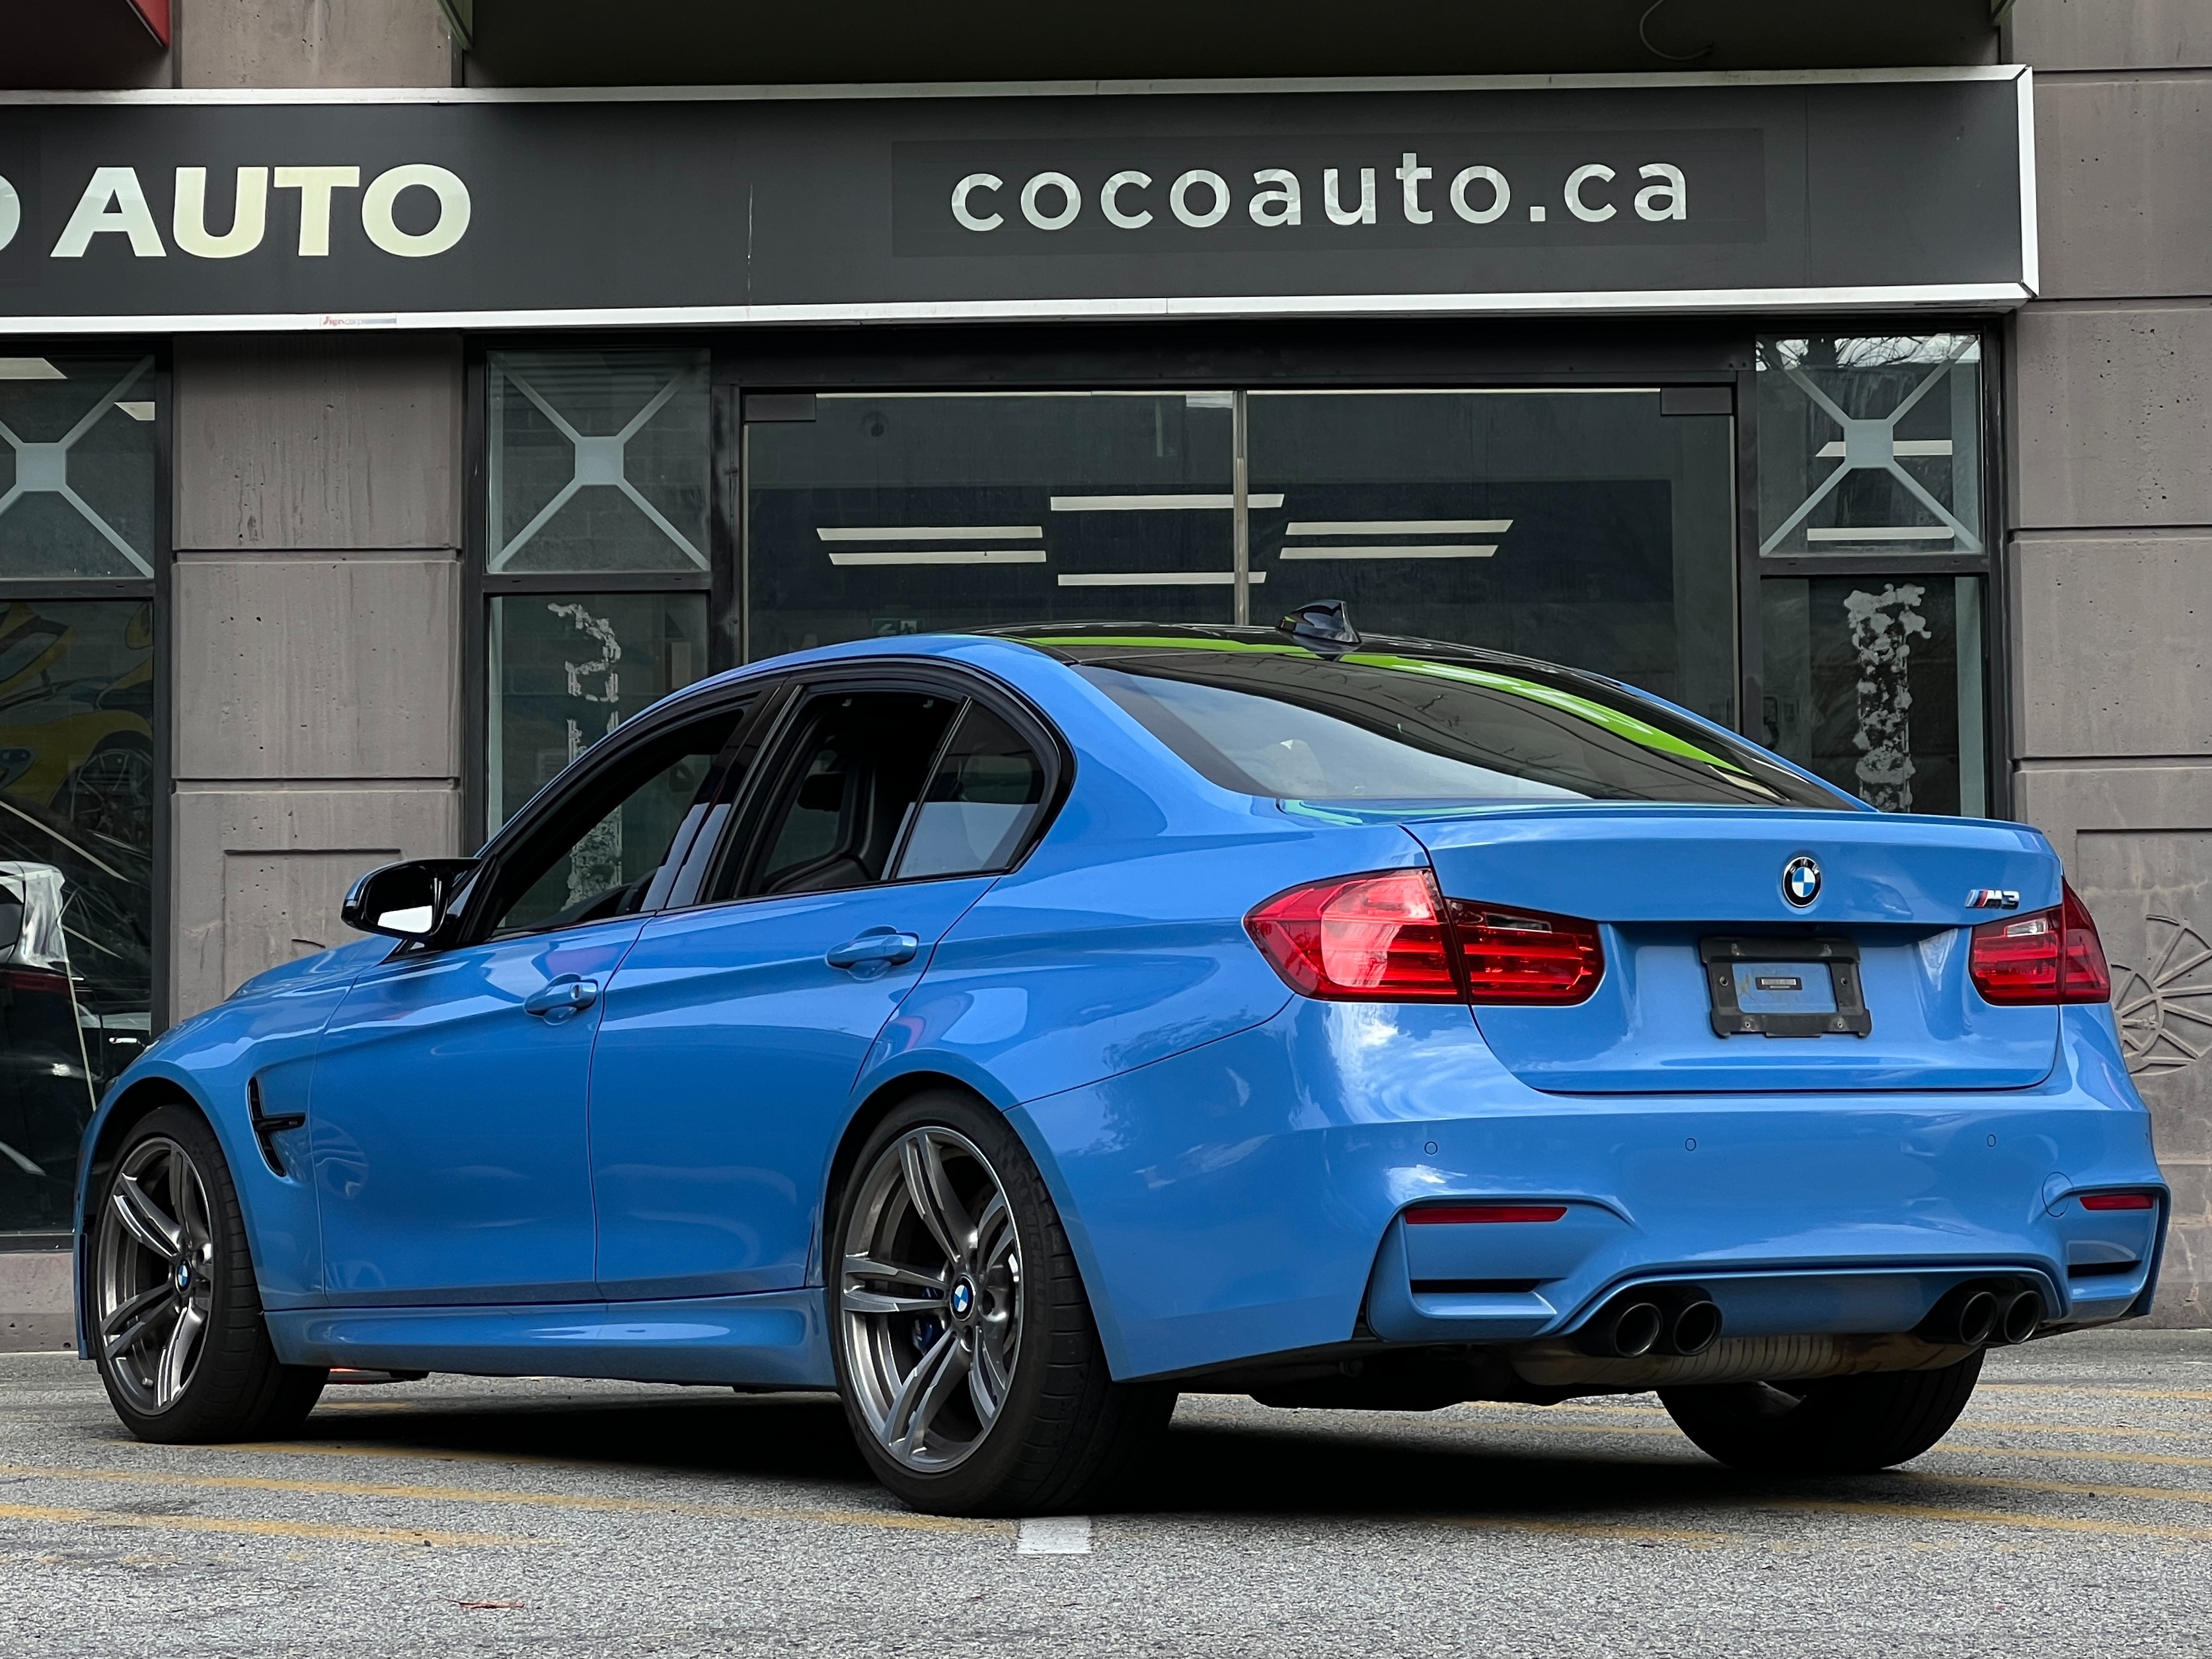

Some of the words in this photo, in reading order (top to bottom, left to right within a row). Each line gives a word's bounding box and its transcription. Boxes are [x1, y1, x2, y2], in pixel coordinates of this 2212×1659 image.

[50, 163, 471, 258] AUTO
[951, 153, 1687, 231] cocoauto.ca
[1981, 889, 2020, 910] M3
